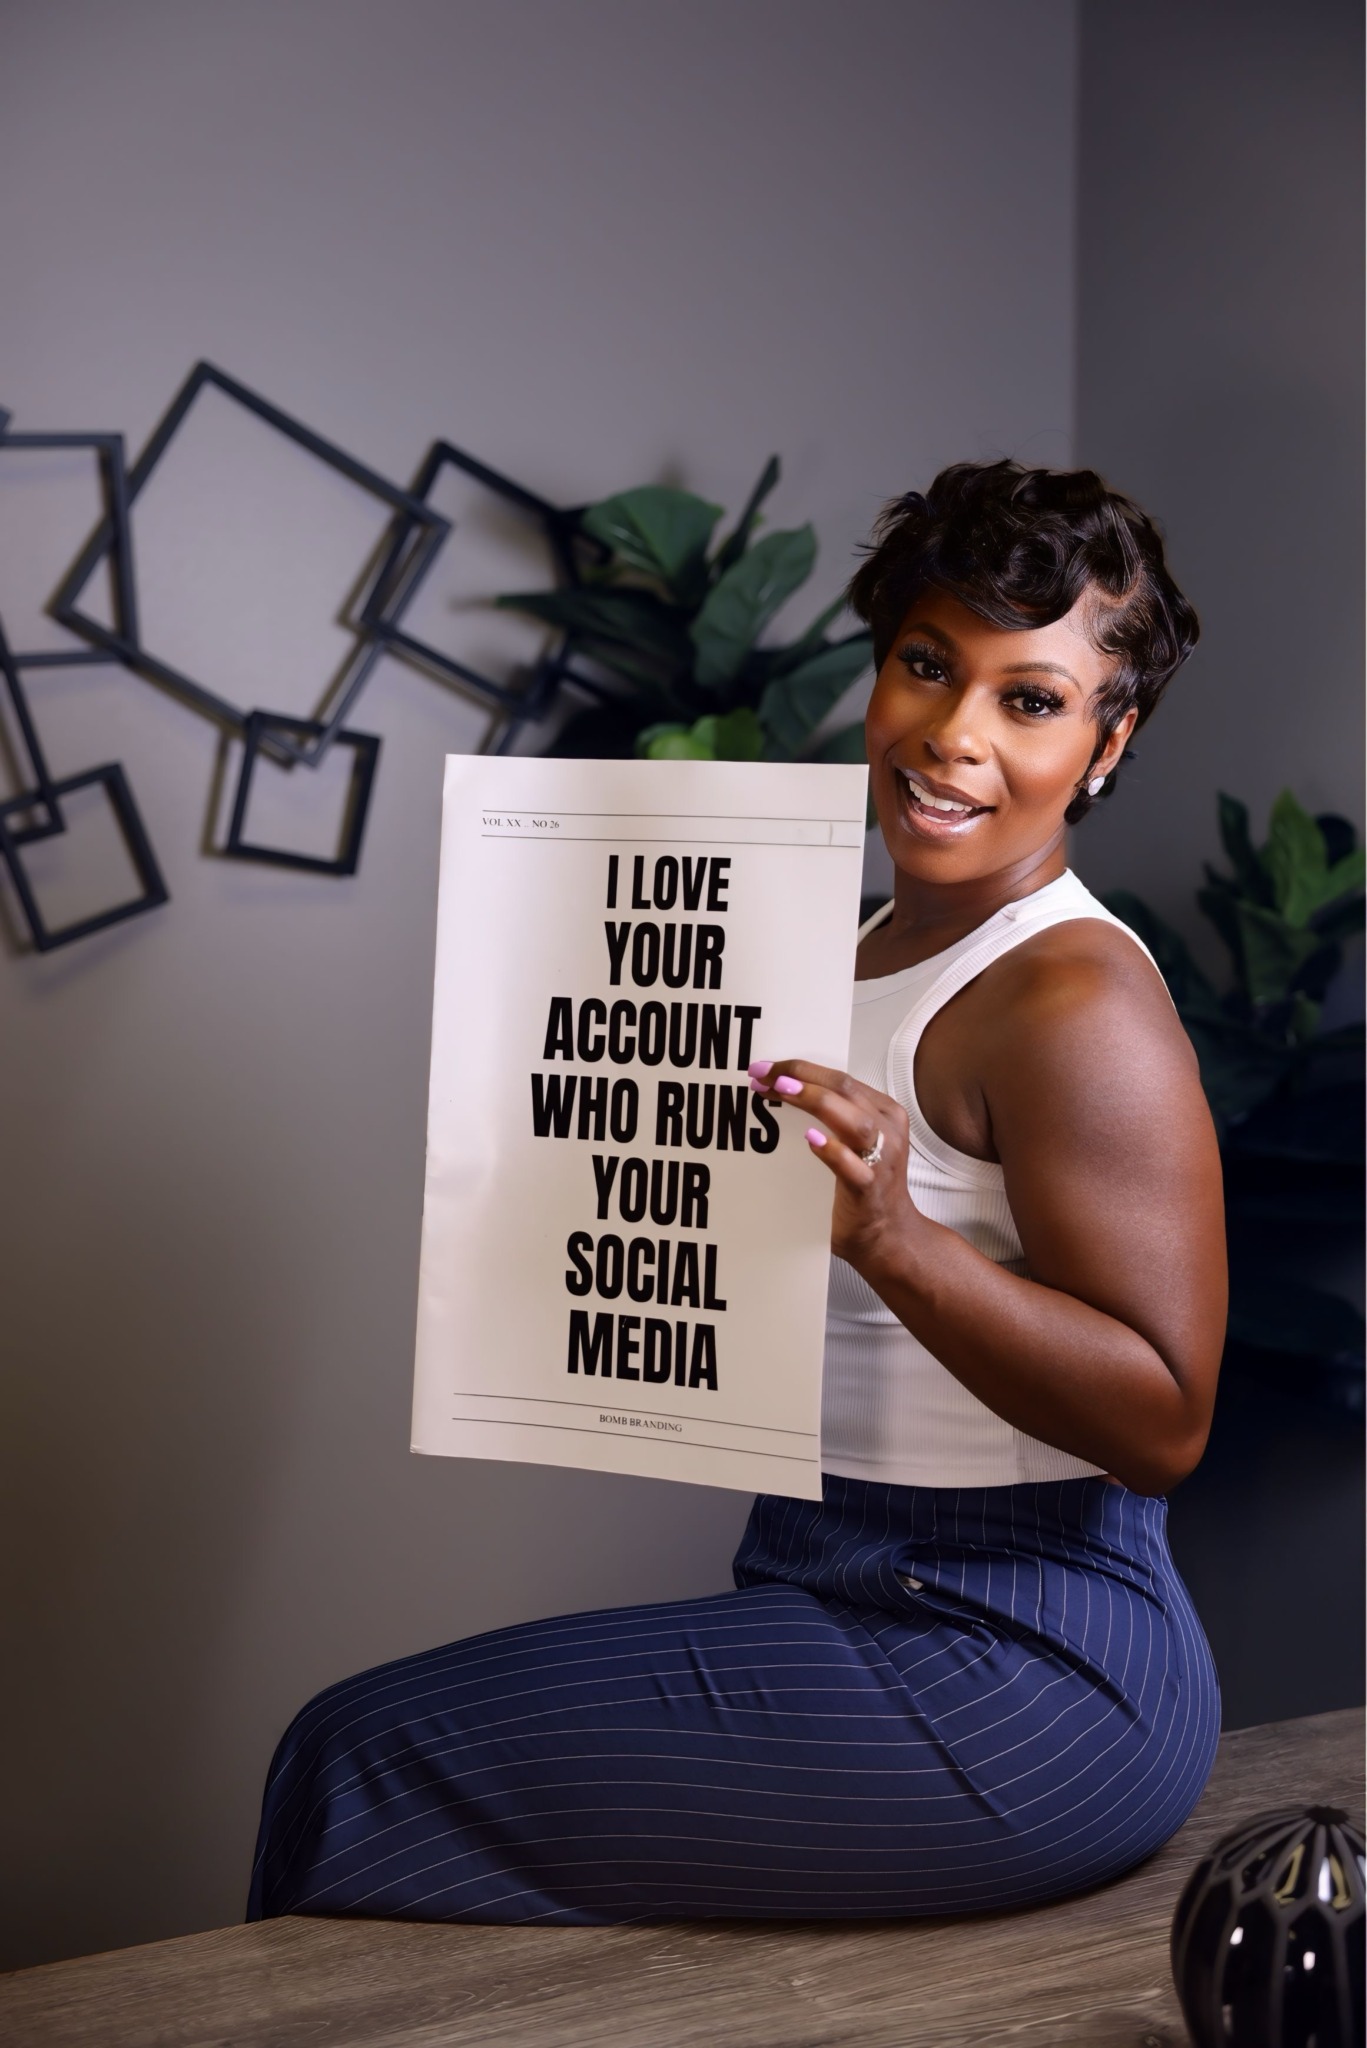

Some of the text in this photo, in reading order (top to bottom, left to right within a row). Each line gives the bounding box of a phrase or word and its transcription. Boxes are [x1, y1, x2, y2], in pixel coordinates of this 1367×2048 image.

[482, 817, 503, 827] VOL
[532, 819, 548, 828] NO
[549, 820, 560, 829] 26
[607, 855, 731, 911] I LOVE
[605, 922, 725, 990] YOUR
[543, 997, 762, 1070] ACCOUNT
[531, 1073, 782, 1154] WHO RUNS
[592, 1155, 710, 1229] YOUR
[566, 1231, 726, 1311] SOCIAL
[568, 1310, 718, 1391] MEDIA
[599, 1414, 683, 1432] BOMB BRANDING
